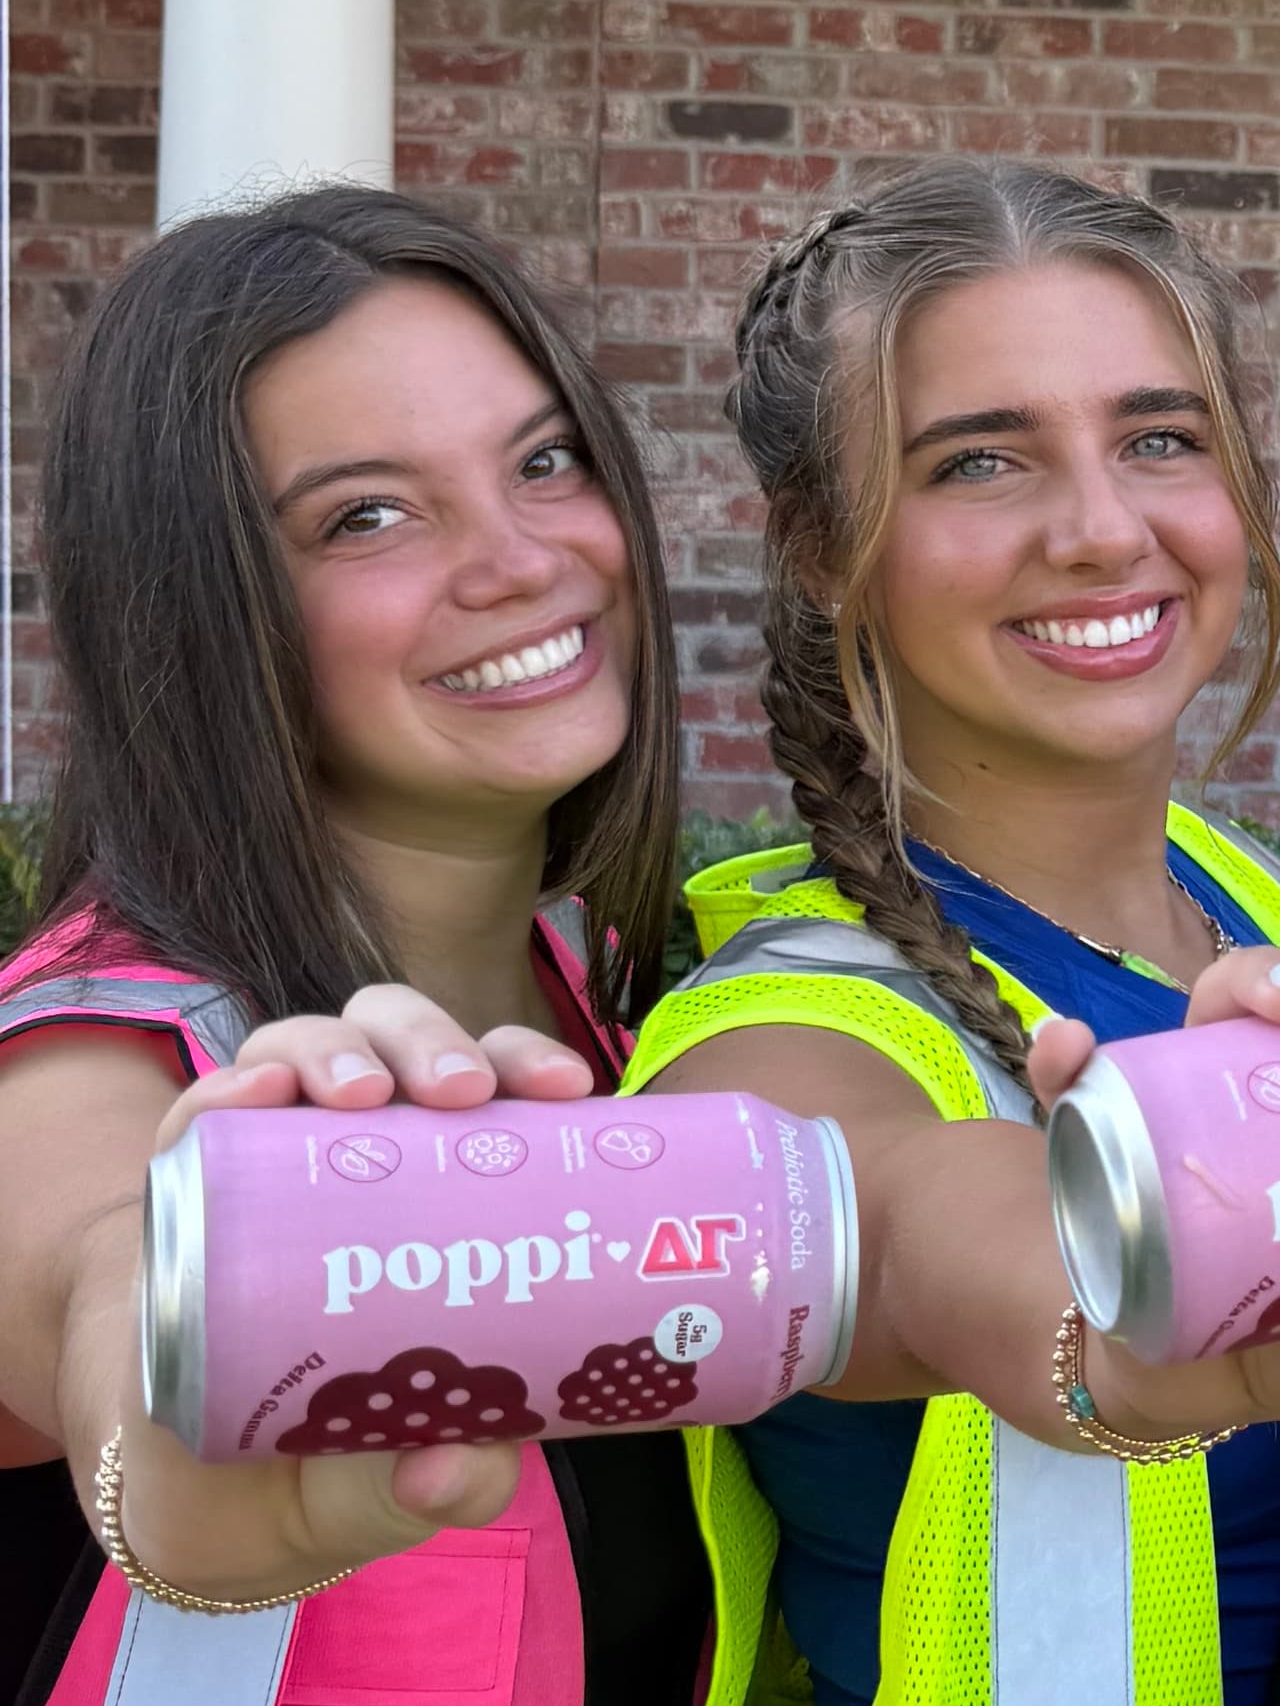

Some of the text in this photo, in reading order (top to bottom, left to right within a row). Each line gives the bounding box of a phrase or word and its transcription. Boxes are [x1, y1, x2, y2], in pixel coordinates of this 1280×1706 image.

[774, 1119, 808, 1270] Prebiotic Soda
[323, 1209, 746, 1314] poppi ΔΓ
[676, 1312, 692, 1357] Sugar
[691, 1324, 707, 1344] 5g
[270, 1351, 326, 1396] Delta
